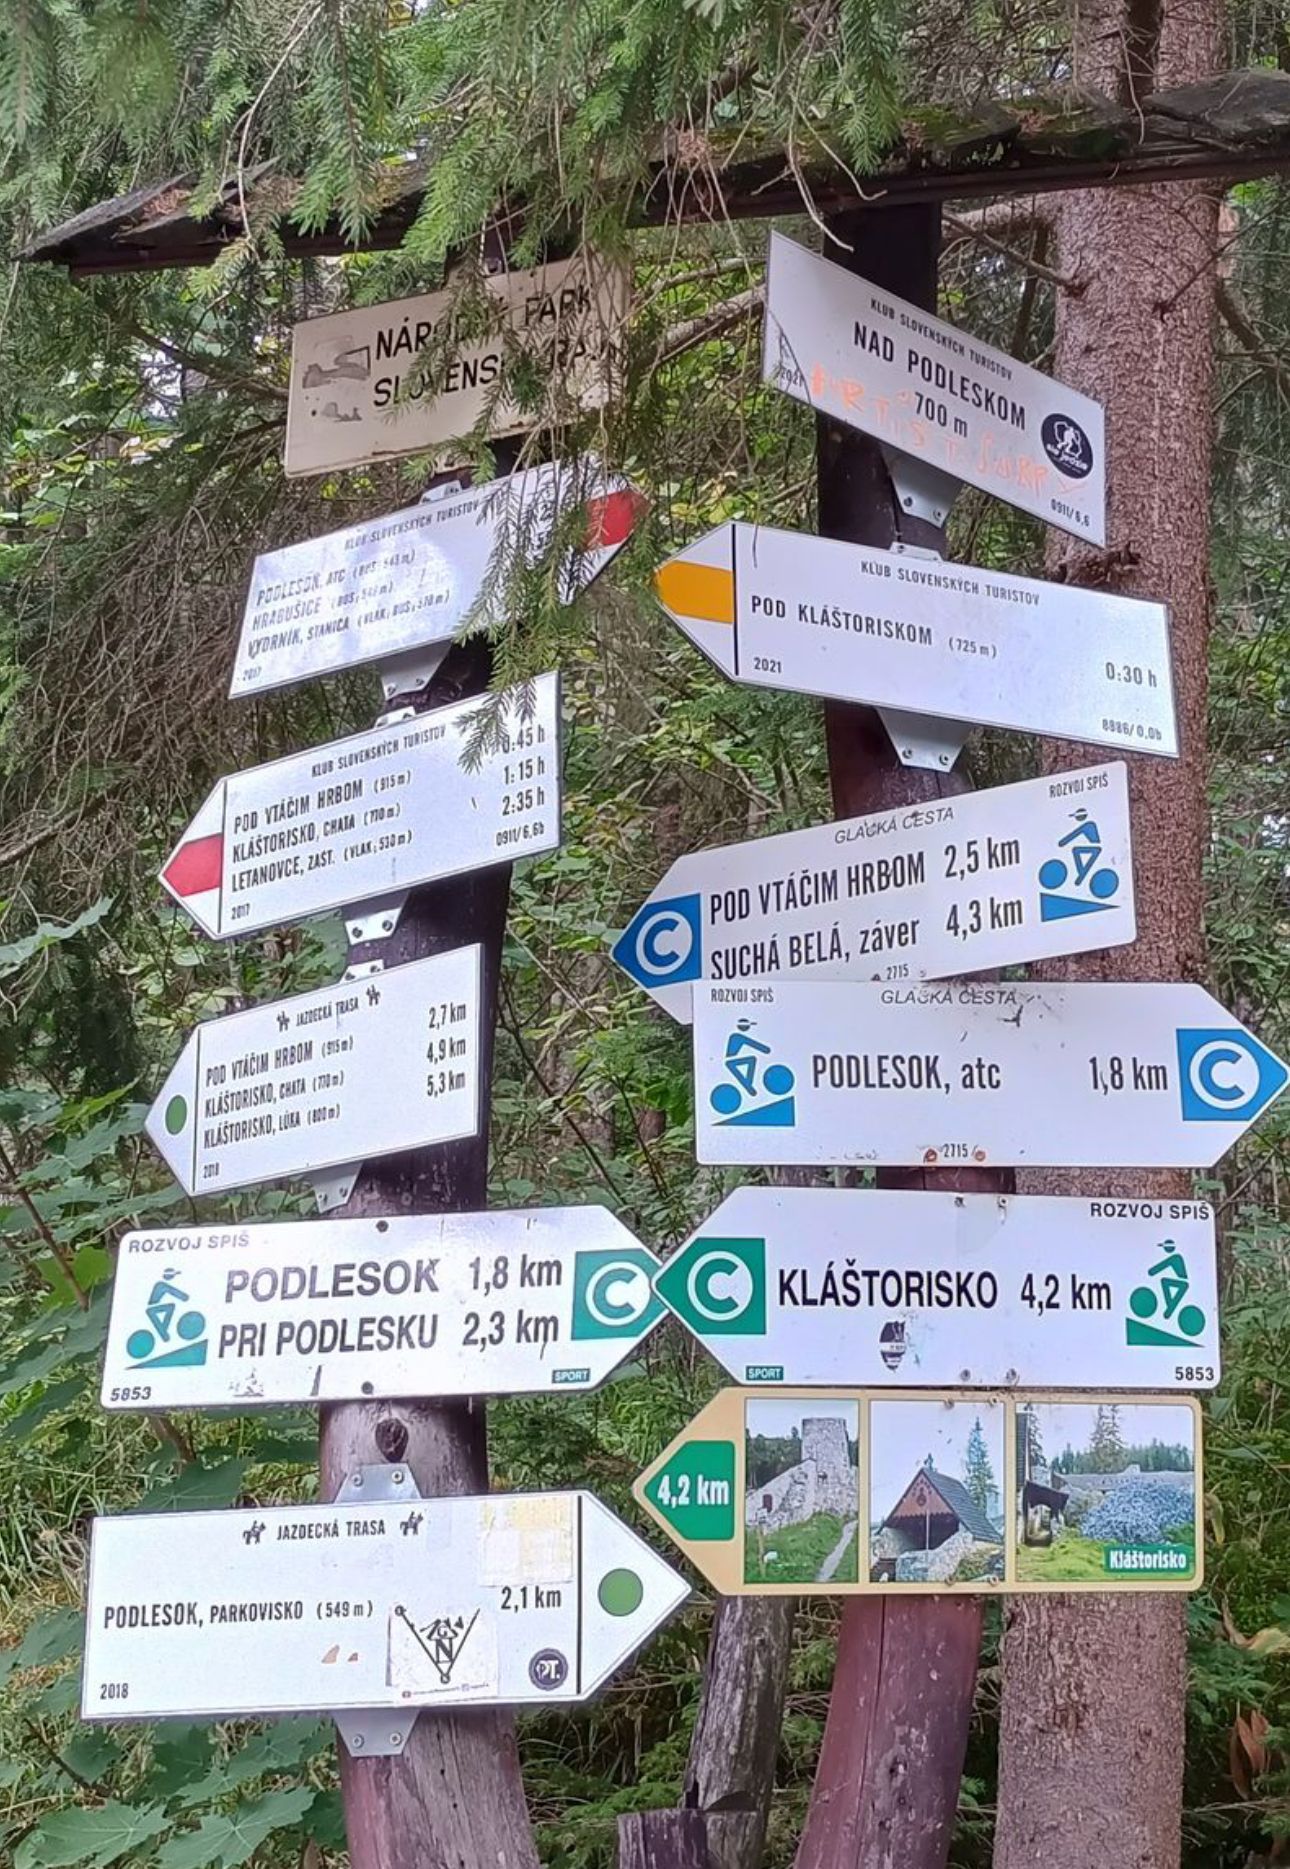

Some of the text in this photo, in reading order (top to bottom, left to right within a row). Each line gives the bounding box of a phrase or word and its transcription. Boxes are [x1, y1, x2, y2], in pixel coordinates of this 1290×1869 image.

[525, 284, 591, 326] PARK
[871, 298, 1012, 380] KLUB SLOVENSKÝCH TURISTOV
[854, 321, 1026, 430] NAD PODLESKOM
[915, 391, 967, 438] 700 m
[437, 499, 479, 523] TURISTOV
[326, 569, 345, 586] ATC
[861, 560, 1040, 605] KLUB SLOVENSKÝCH TURISTOV
[252, 596, 321, 631] HRABUŠICE
[307, 615, 350, 641] STANICA
[751, 595, 786, 618] POD
[798, 603, 932, 646] KLÁŠTORISKOM
[753, 657, 783, 674] 2021
[1105, 661, 1158, 688] 0:30 h
[538, 724, 545, 744] h
[312, 724, 446, 777] KLUB SLOVENSKÝCH TURISTOV
[504, 756, 545, 785] 1:15 h
[1049, 772, 1109, 799] ROZVOJ SPIŠ
[234, 810, 258, 834] POD
[265, 793, 310, 825] VTÁČIM
[317, 778, 363, 809] HRBOM
[502, 786, 545, 816] 2:35 h
[902, 807, 954, 831] CESTA
[232, 822, 319, 864] KLÁŠTORISKO,
[323, 814, 355, 837] CHATA
[231, 855, 304, 892] LETANOVCE,
[710, 837, 1020, 925] POD VTÁČIM HRBOM 2,5 km
[231, 903, 250, 920] 2017
[710, 896, 1023, 981] SUCHÁ BELÁ, záver 4,3 km
[886, 964, 910, 981] 2715
[711, 986, 775, 1004] ROZVOJ SPIŠ
[959, 988, 1018, 1006] CESTA
[296, 997, 359, 1027] JAZDECKÁ TRASA
[429, 1002, 466, 1030] 2,7 km
[206, 1065, 226, 1087] POD
[232, 1052, 268, 1081] VTÁČIM
[275, 1040, 313, 1069] HRBOM
[427, 1036, 466, 1064] 4,9 km
[427, 1070, 466, 1098] 5,3 km
[812, 1054, 951, 1095] PODLESOK,
[962, 1058, 1001, 1090] atc
[1090, 1055, 1124, 1095] 1,8
[1132, 1056, 1168, 1091] km
[205, 1082, 276, 1119] KLÁŠTORISKO,
[279, 1078, 306, 1100] CHATA
[203, 1113, 276, 1149] KLÁŠTORISKO,
[943, 1143, 968, 1158] 2715
[1090, 1201, 1210, 1221] ROZVOJ SPIŠ
[128, 1231, 250, 1254] ROZVOJ SPIŠ
[225, 1254, 563, 1303] PODLESOK 1,8 km
[779, 1259, 998, 1308] KLÁŠTORISKO
[1020, 1273, 1060, 1316] 4,2
[1071, 1272, 1112, 1310] km
[219, 1310, 559, 1359] PRI PODLESKU 2,3 km
[553, 1369, 590, 1383] SPORT
[747, 1367, 782, 1380] SPORT
[1175, 1366, 1215, 1382] 5853
[110, 1386, 152, 1402] 5853
[657, 1472, 729, 1508] 4,2 km
[276, 1518, 386, 1541] JAZDECKÁ TRASA
[1109, 1549, 1188, 1570] Kláštorisko
[501, 1584, 562, 1613] 2,1 km
[103, 1602, 204, 1630] PODLESOK,
[210, 1600, 303, 1625] PARKOVISKO
[100, 1684, 129, 1701] 2018
